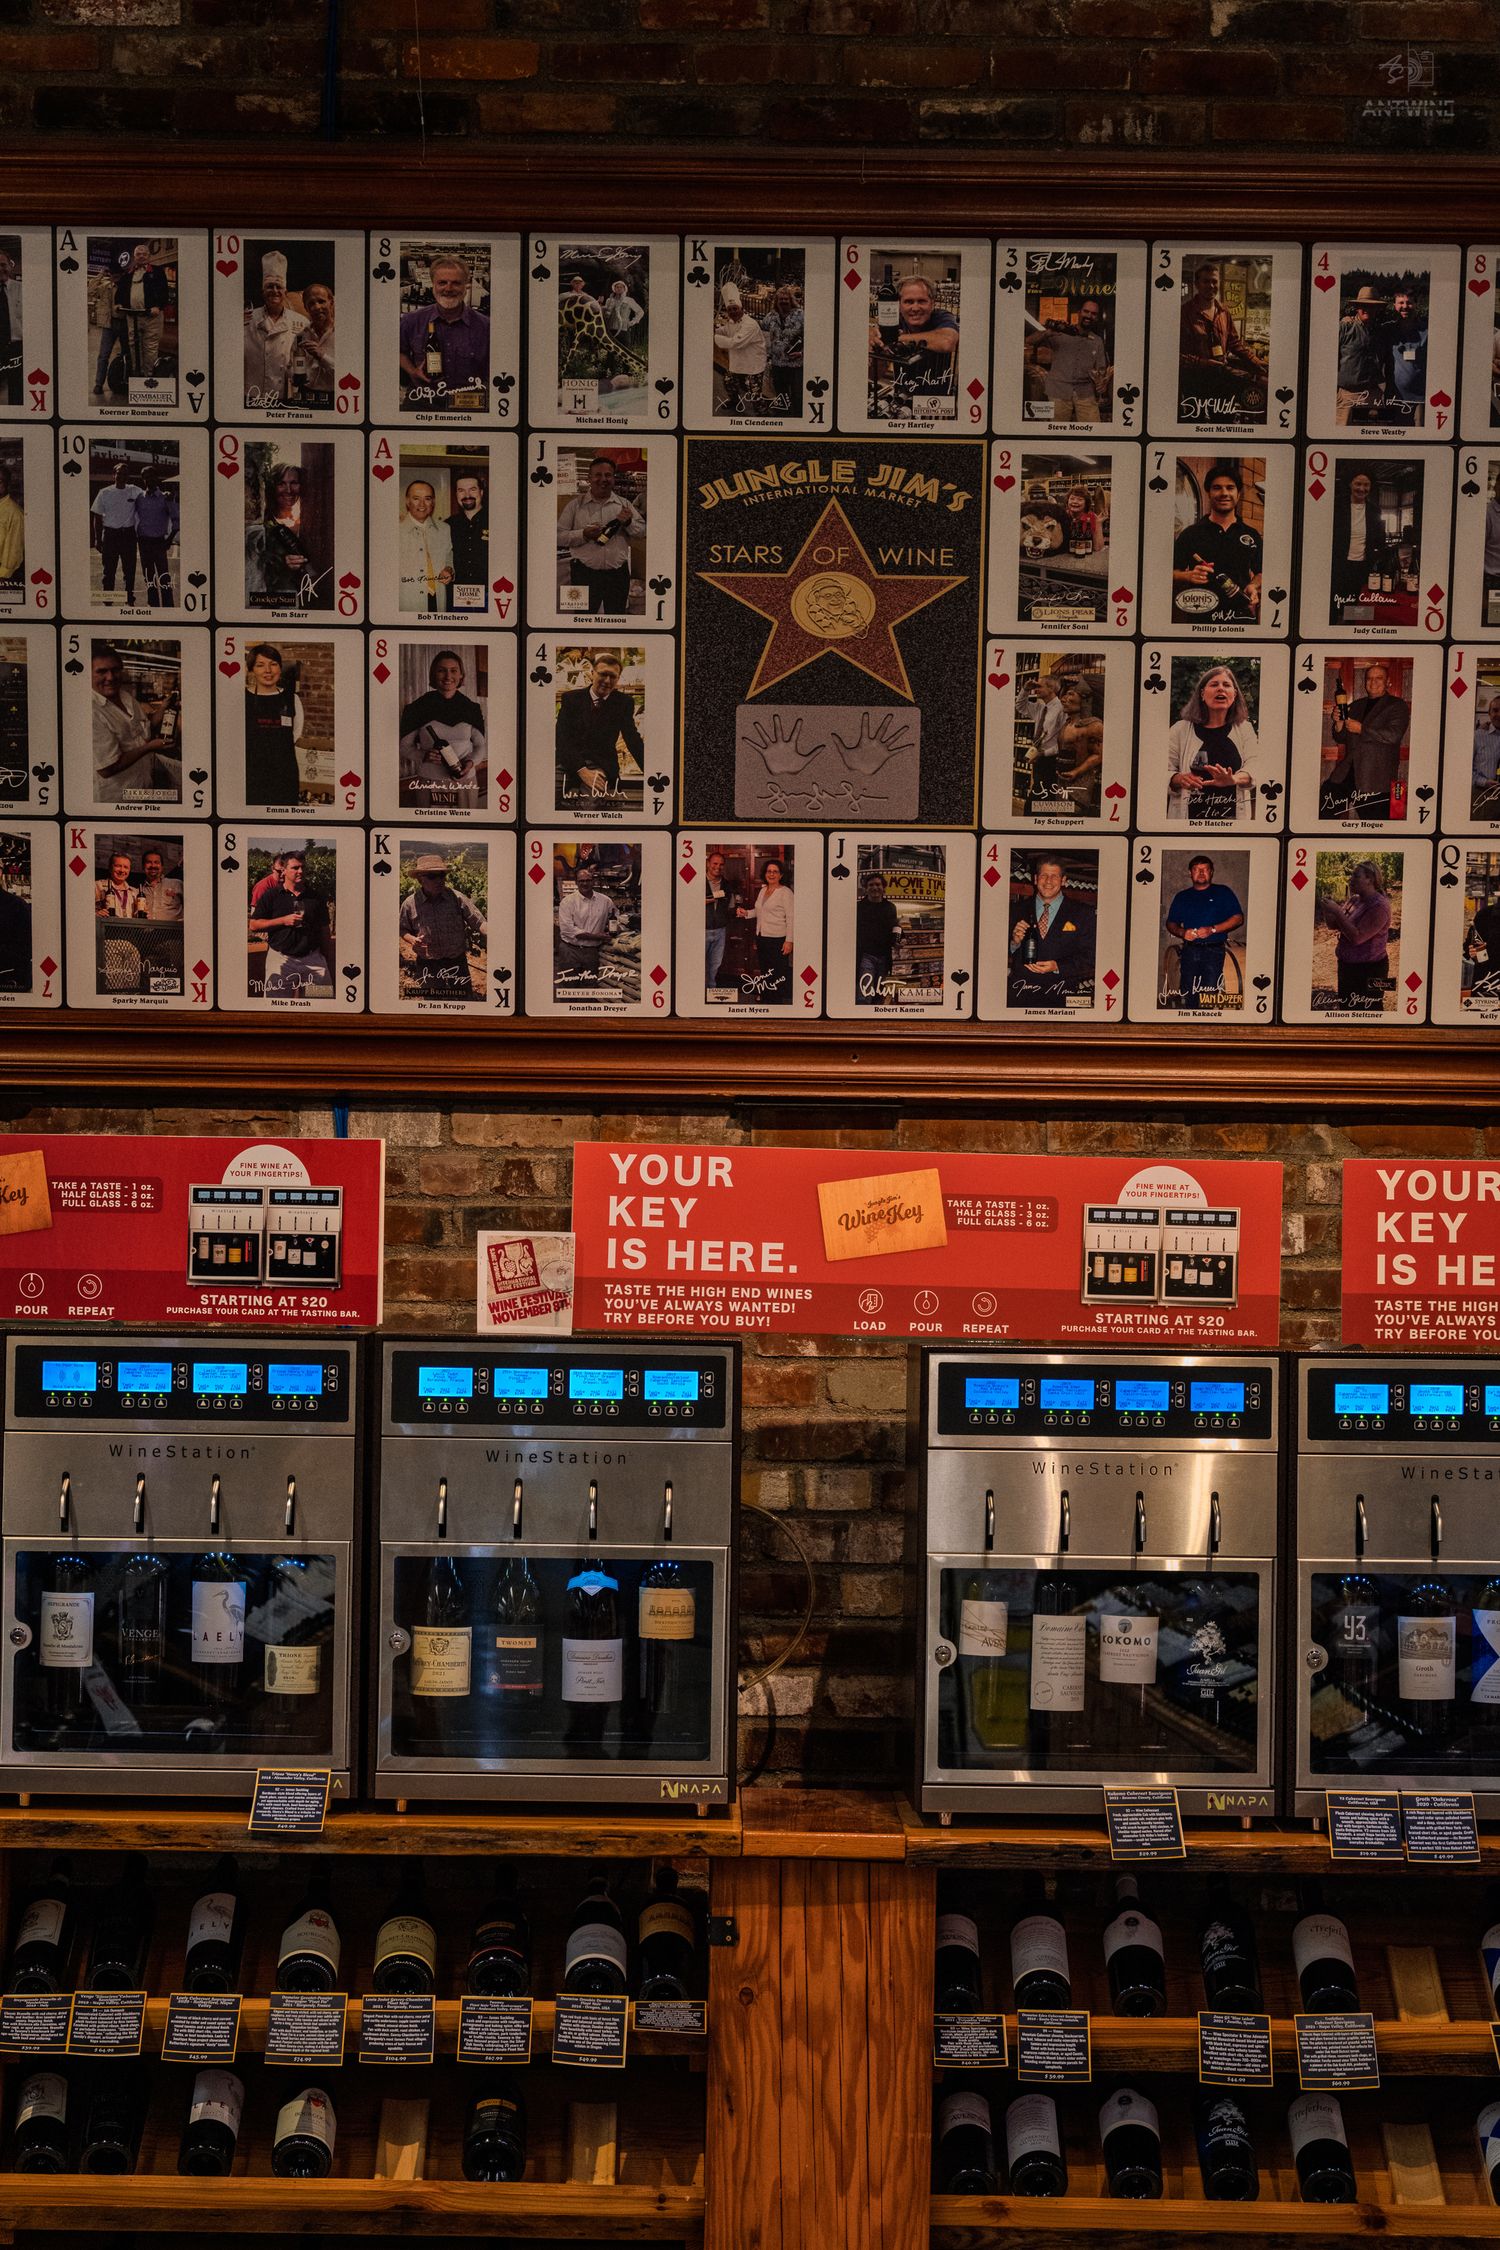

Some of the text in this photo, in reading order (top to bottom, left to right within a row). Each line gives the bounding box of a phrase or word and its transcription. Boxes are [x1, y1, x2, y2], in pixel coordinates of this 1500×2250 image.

[60, 230, 78, 251] A
[216, 236, 240, 254] 10
[691, 240, 708, 261] K
[846, 245, 859, 264] 6
[1318, 252, 1329, 271] 4
[415, 414, 433, 422] Chip
[606, 417, 628, 425] Honig
[888, 421, 935, 430] Gary Hartley
[1068, 424, 1093, 432] Moody
[1381, 428, 1406, 437] Westby
[219, 434, 239, 460] Q
[538, 440, 546, 461] J
[1154, 452, 1165, 470] 7
[700, 460, 974, 512] JUNGLE JIM'S
[743, 485, 922, 508] INTERNATIONAL MARKET
[710, 545, 954, 566] STARS OF WINE
[1192, 625, 1217, 633] Phillip
[1353, 627, 1370, 636] Judy
[1034, 817, 1084, 826] Jay Schuppert
[112, 997, 169, 1005] Sparky Marquis
[443, 1003, 466, 1011] Krupp
[609, 1153, 734, 1187] YOUR
[52, 1181, 77, 1190] TAKE
[90, 1182, 121, 1191] TASTE
[1376, 1170, 1500, 1201] YOUR
[61, 1190, 86, 1198] HALF
[89, 1191, 121, 1199] GLASS
[609, 1196, 698, 1228] KEY
[1377, 1212, 1467, 1243] KEY
[607, 1238, 798, 1273] IS HERE.
[605, 1284, 813, 1300] TASTE THE HIGH END WINES
[15, 1305, 48, 1315] POUR
[68, 1306, 115, 1316] REPEAT
[488, 1298, 519, 1313] WINE
[604, 1298, 796, 1313] YOU'VE ALWAYS WANTED!
[492, 1303, 552, 1325] NOVEMBER
[604, 1313, 770, 1327] TRY BEFORE YOU BUY!
[1095, 1313, 1225, 1326] STARTING AT $20
[853, 1321, 886, 1331] LOAD
[909, 1322, 943, 1332] POUR
[962, 1324, 1009, 1334] REPEAT
[109, 1444, 250, 1459] WineStation
[486, 1450, 627, 1464] WineStation
[1032, 1461, 1173, 1476] WineStation
[121, 1627, 159, 1639] VENGE
[680, 1783, 722, 1795] NAPA
[1226, 1795, 1268, 1806] NAPA
